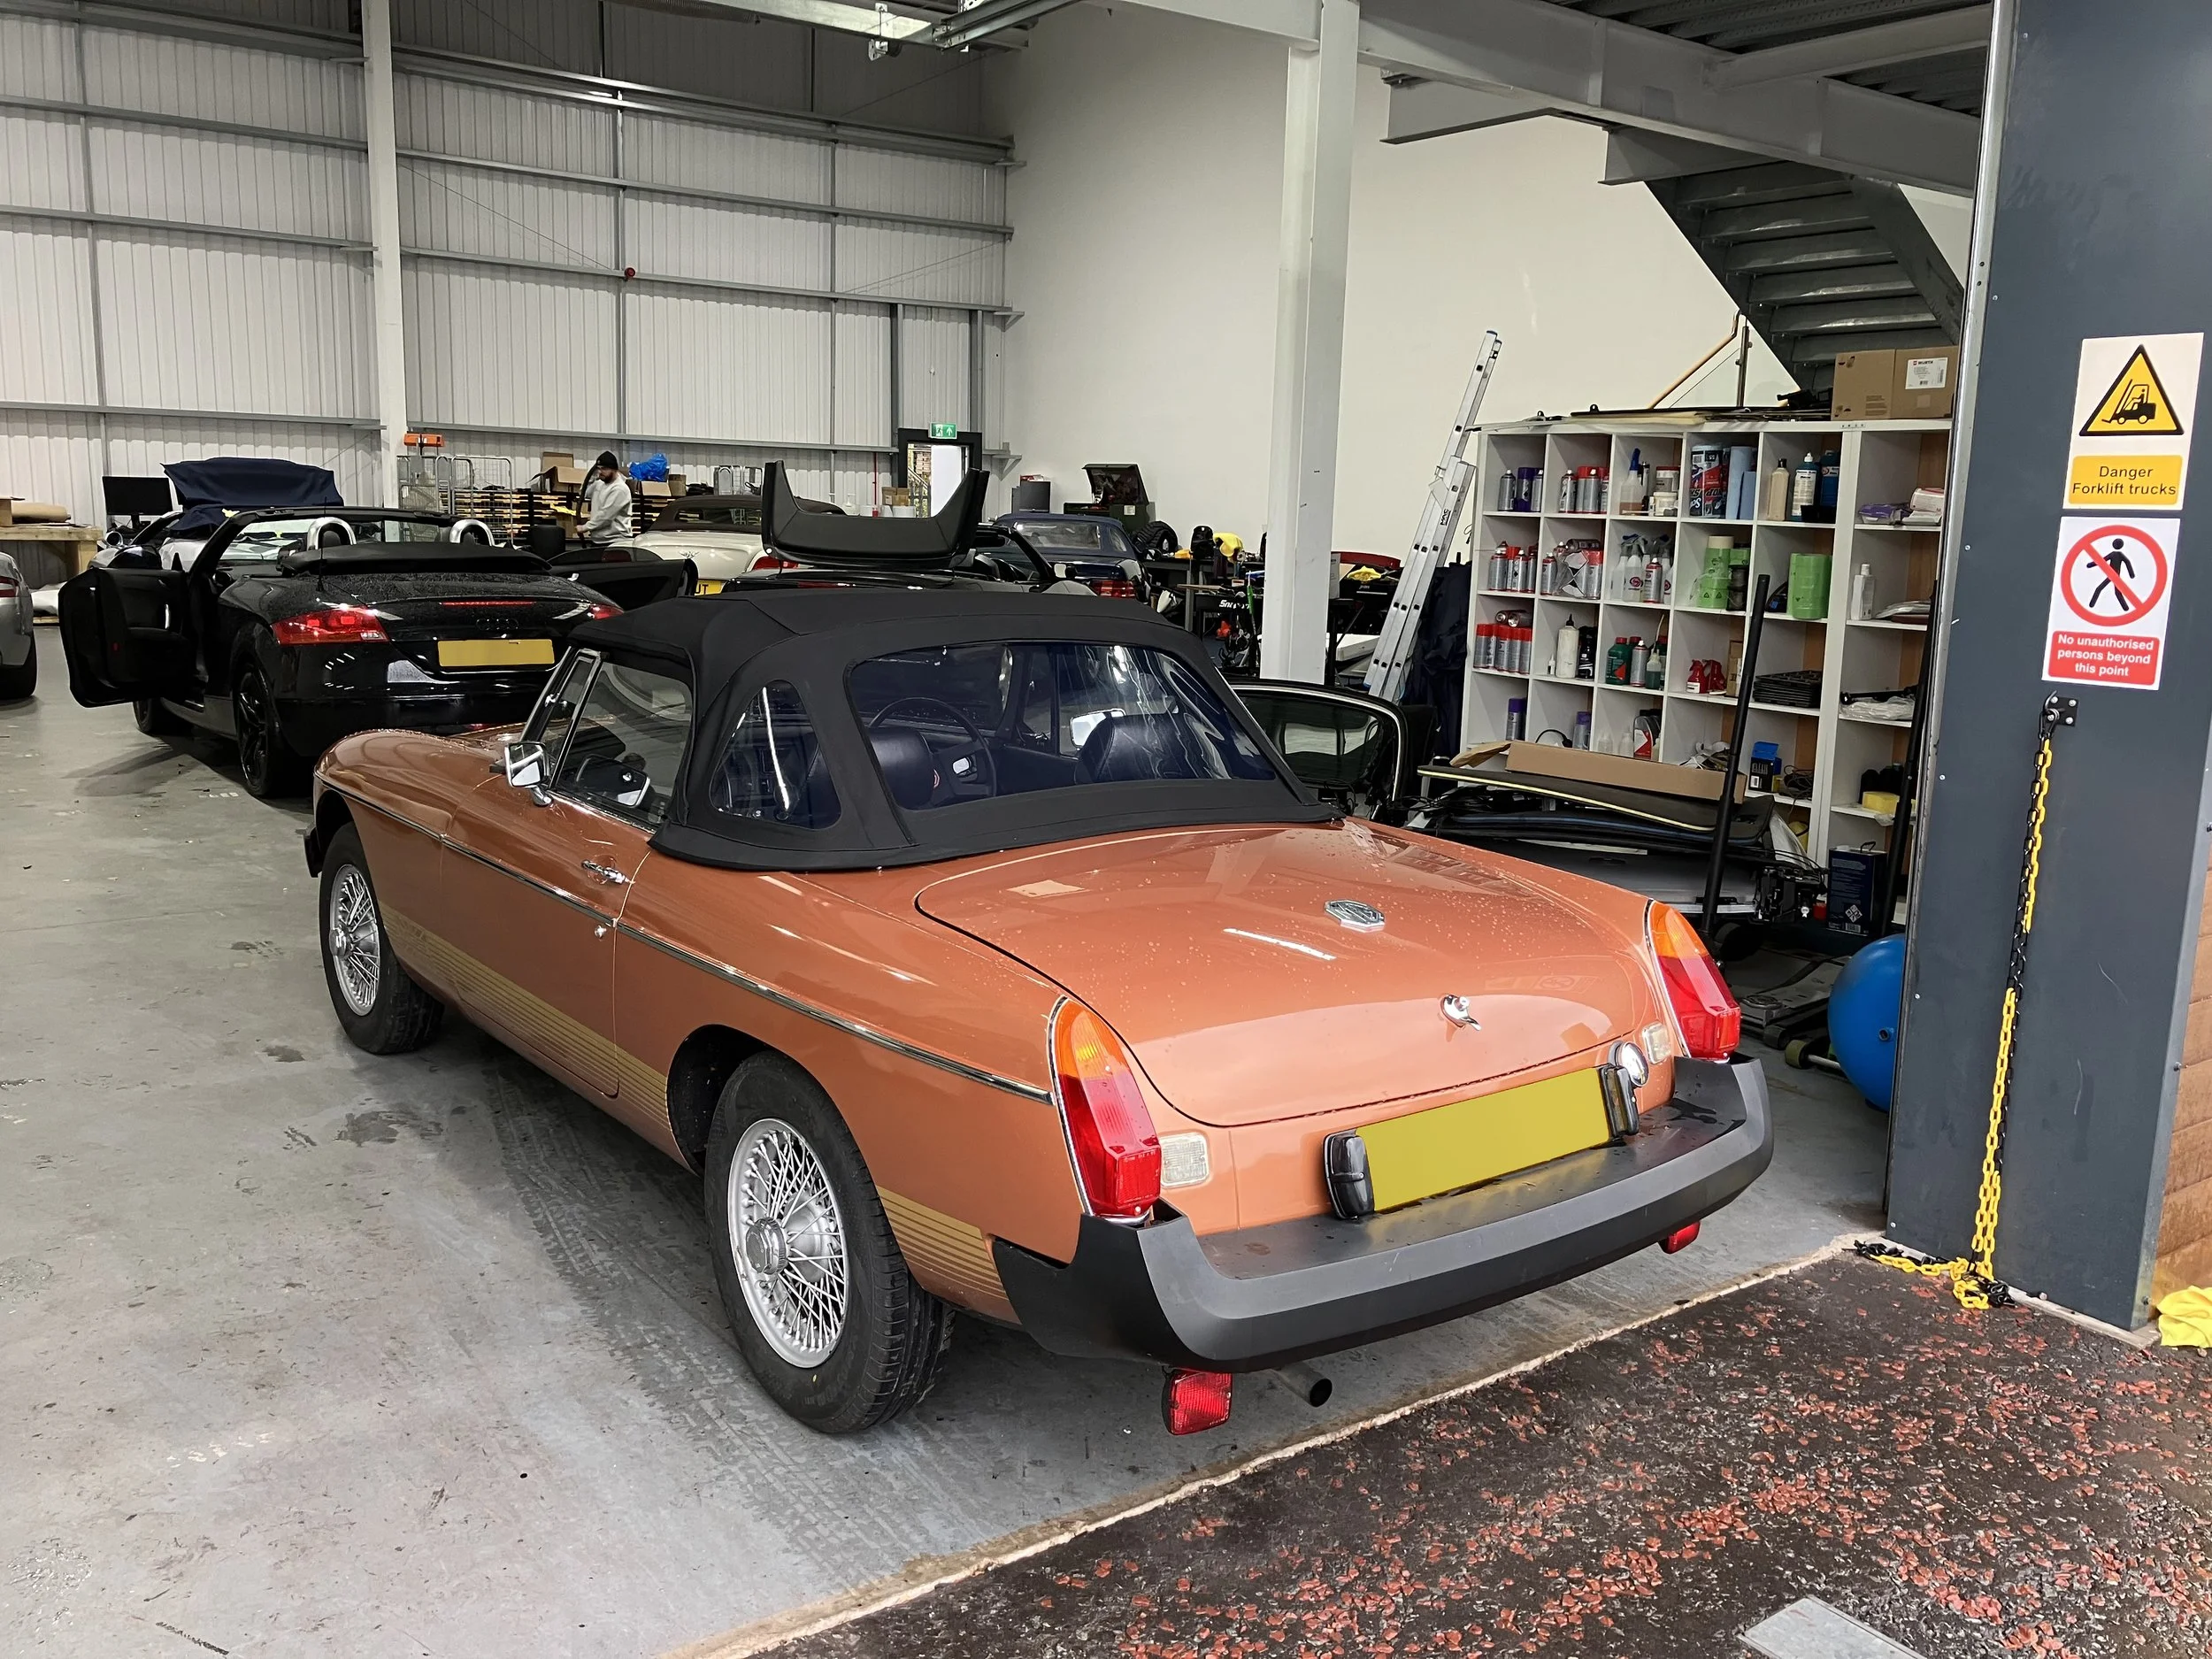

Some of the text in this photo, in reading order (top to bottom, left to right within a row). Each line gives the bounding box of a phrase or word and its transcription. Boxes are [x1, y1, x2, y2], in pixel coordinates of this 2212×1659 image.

[2099, 465, 2154, 480] Danger
[2072, 482, 2177, 495] Forklift trucks
[2058, 634, 2154, 650] No unauthorised
[2057, 649, 2151, 664] persons beyond
[2075, 662, 2129, 677] this point
